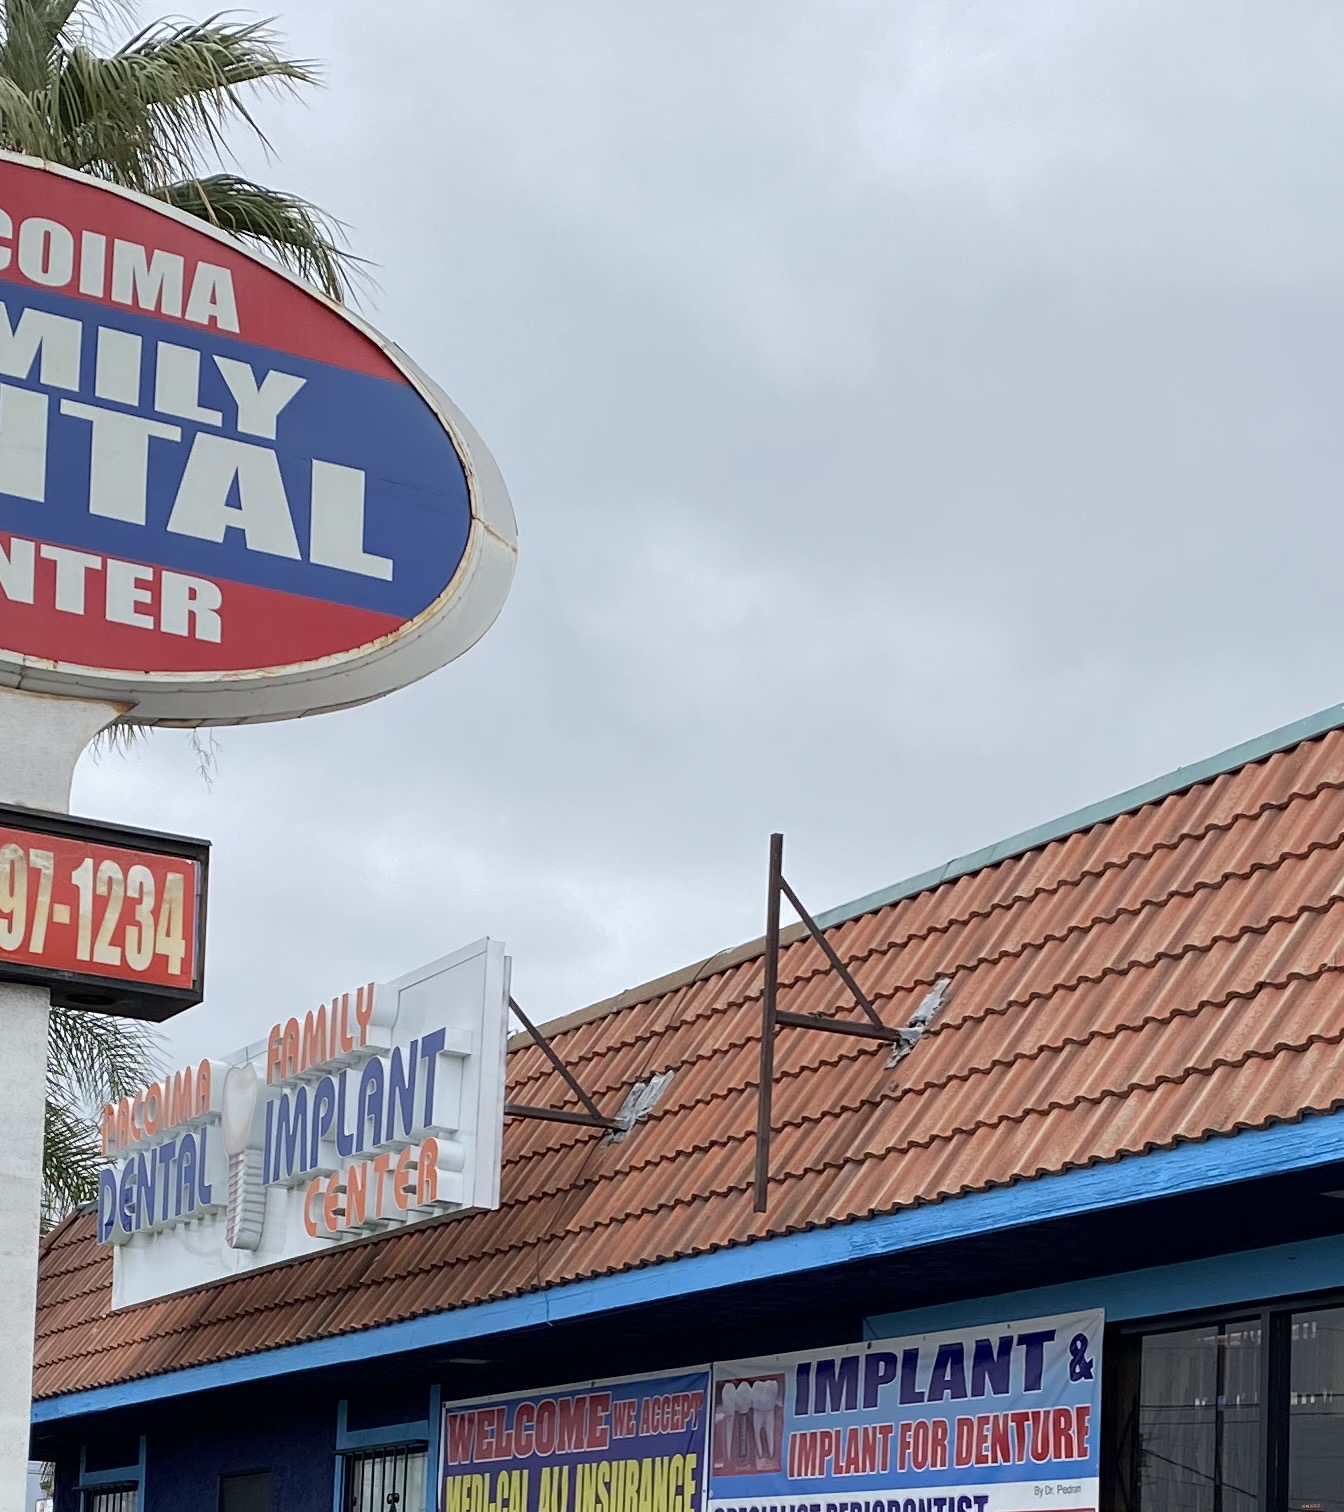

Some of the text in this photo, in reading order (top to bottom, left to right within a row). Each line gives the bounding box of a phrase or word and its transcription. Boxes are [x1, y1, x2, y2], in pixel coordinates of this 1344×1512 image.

[266, 982, 376, 1086] FAMILY
[101, 1058, 212, 1157] PACOIMA
[263, 1027, 446, 1185] IMPLANT
[97, 1122, 212, 1245] DENTAL
[304, 1137, 439, 1238] CENTER
[793, 1328, 1095, 1416] IMPLANT &
[447, 1390, 705, 1466] WELCOME WE ACCEPT
[787, 1405, 1092, 1480] IMPLANT FOR DENTURE
[1033, 1485, 1044, 1498] By
